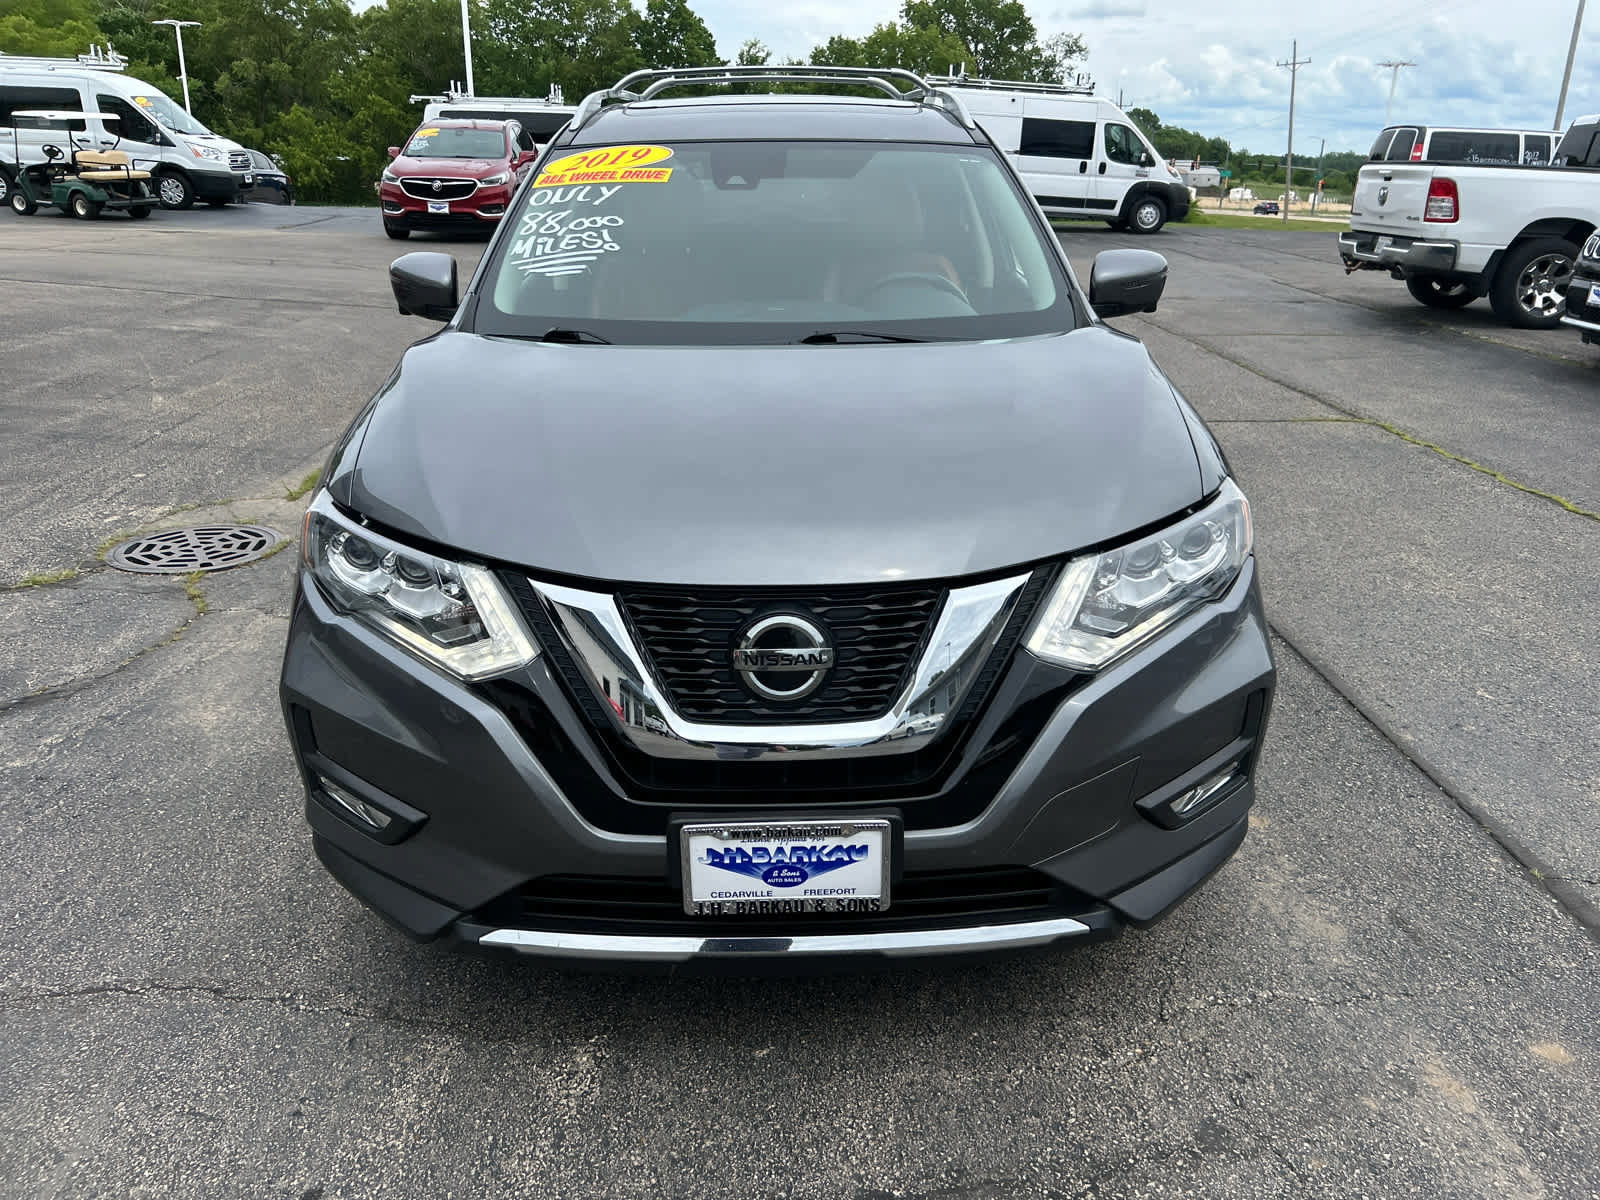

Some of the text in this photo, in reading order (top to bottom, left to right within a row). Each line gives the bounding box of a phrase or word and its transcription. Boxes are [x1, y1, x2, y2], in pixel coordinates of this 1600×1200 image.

[564, 148, 651, 171] 2019
[538, 169, 670, 185] ALL WHEEL DRIVE
[529, 185, 623, 206] ONLY
[520, 210, 624, 236] 88,000
[743, 653, 823, 666] NISSAN
[731, 826, 841, 839] www.barkau.com
[711, 888, 857, 898] CEDARVILLE FREEPORT
[736, 900, 804, 914] BARKAU
[815, 898, 827, 912] &
[836, 898, 881, 913] SONS
